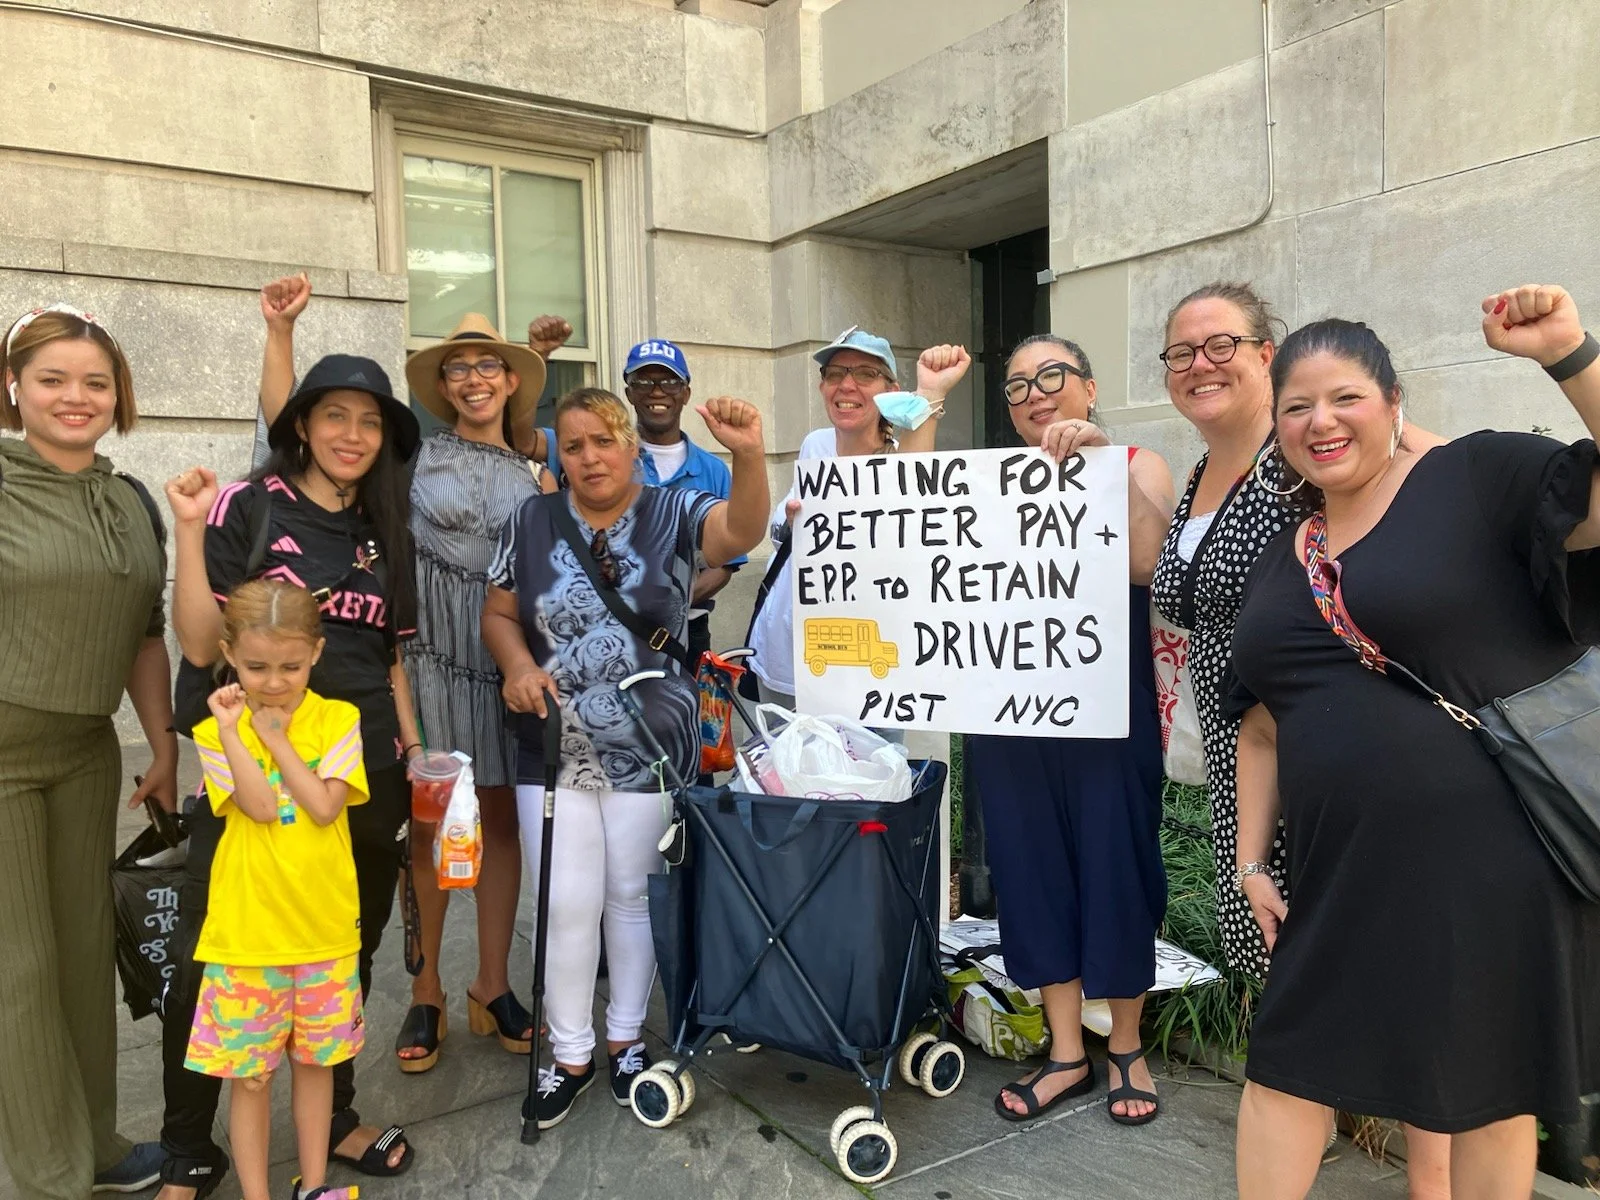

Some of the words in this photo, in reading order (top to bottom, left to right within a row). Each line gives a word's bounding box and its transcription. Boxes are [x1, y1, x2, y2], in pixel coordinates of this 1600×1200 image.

[639, 342, 675, 361] SLU
[797, 457, 970, 500] WAITING
[1000, 452, 1087, 496] FOR
[803, 505, 983, 556] BETTER
[1017, 501, 1087, 550] PAY
[931, 555, 1081, 602] RETAIN
[914, 614, 1103, 671] DRIVERS
[860, 690, 947, 721] PIST
[995, 694, 1079, 727] NYC
